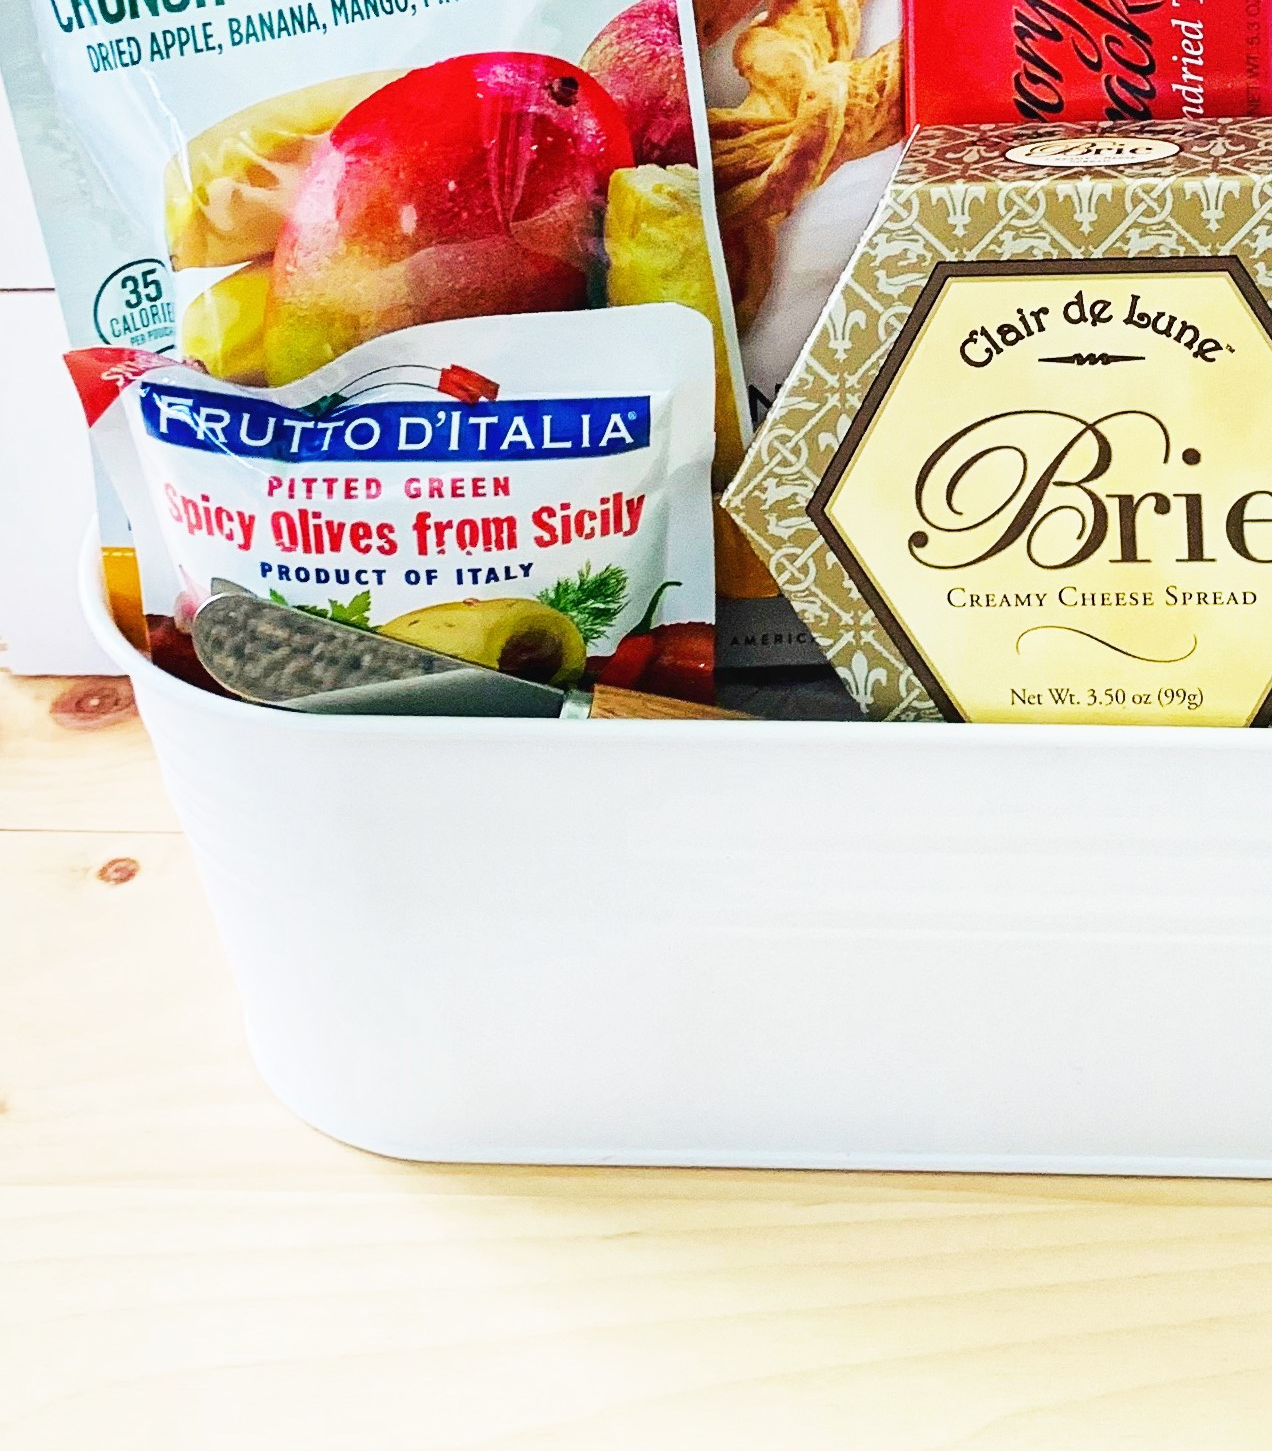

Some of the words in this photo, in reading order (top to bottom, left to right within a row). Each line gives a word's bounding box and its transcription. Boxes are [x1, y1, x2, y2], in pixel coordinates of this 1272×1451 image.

[87, 39, 142, 73] DRIED
[150, 23, 223, 58] APPLE,
[229, 6, 327, 46] BANANA,
[1172, 19, 1203, 119] ndried
[120, 268, 163, 309] 35
[110, 302, 175, 338] CALORIE
[959, 307, 1050, 368] Clair
[1062, 290, 1113, 326] de
[159, 397, 381, 454] FRUTTO
[267, 476, 383, 500] PITTED
[404, 476, 511, 498] GREEN
[164, 482, 257, 552] Spicy
[271, 507, 398, 556] Olives
[412, 510, 517, 556] from
[532, 492, 646, 549] Sicily
[260, 561, 387, 585] PRODUCT
[406, 568, 436, 586] OF
[456, 561, 534, 586] ITALY
[946, 587, 1048, 608] CREAMY
[1058, 586, 1154, 607] CHEESE
[1165, 585, 1257, 606] SPREAD
[1010, 688, 1042, 705] Net
[1048, 688, 1080, 705] Wt.
[1087, 688, 1126, 706] 3.50
[1132, 693, 1152, 705] oz
[1157, 687, 1204, 710] (99g)
